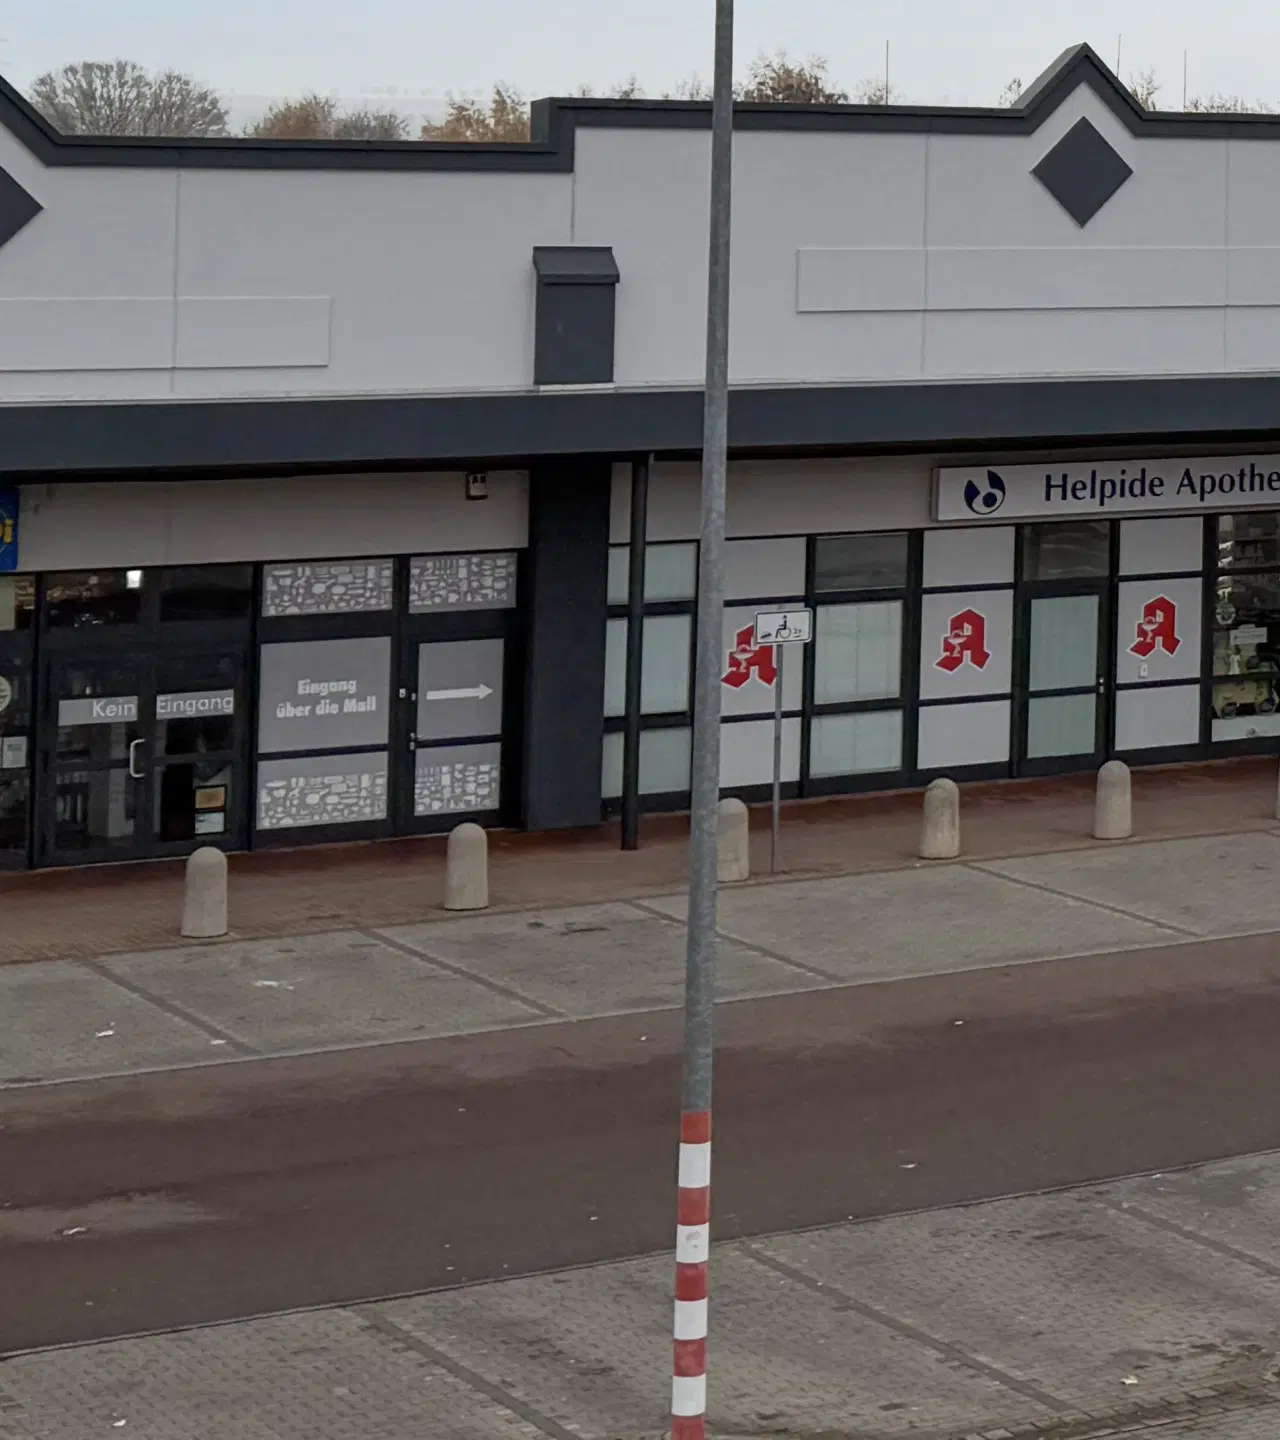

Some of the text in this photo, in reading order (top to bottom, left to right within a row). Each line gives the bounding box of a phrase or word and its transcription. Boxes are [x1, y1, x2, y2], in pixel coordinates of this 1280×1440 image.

[1044, 469, 1165, 506] Helpide
[297, 678, 358, 696] Eingang
[92, 694, 234, 718] Kein Eingang
[276, 695, 377, 719] über die Mall
